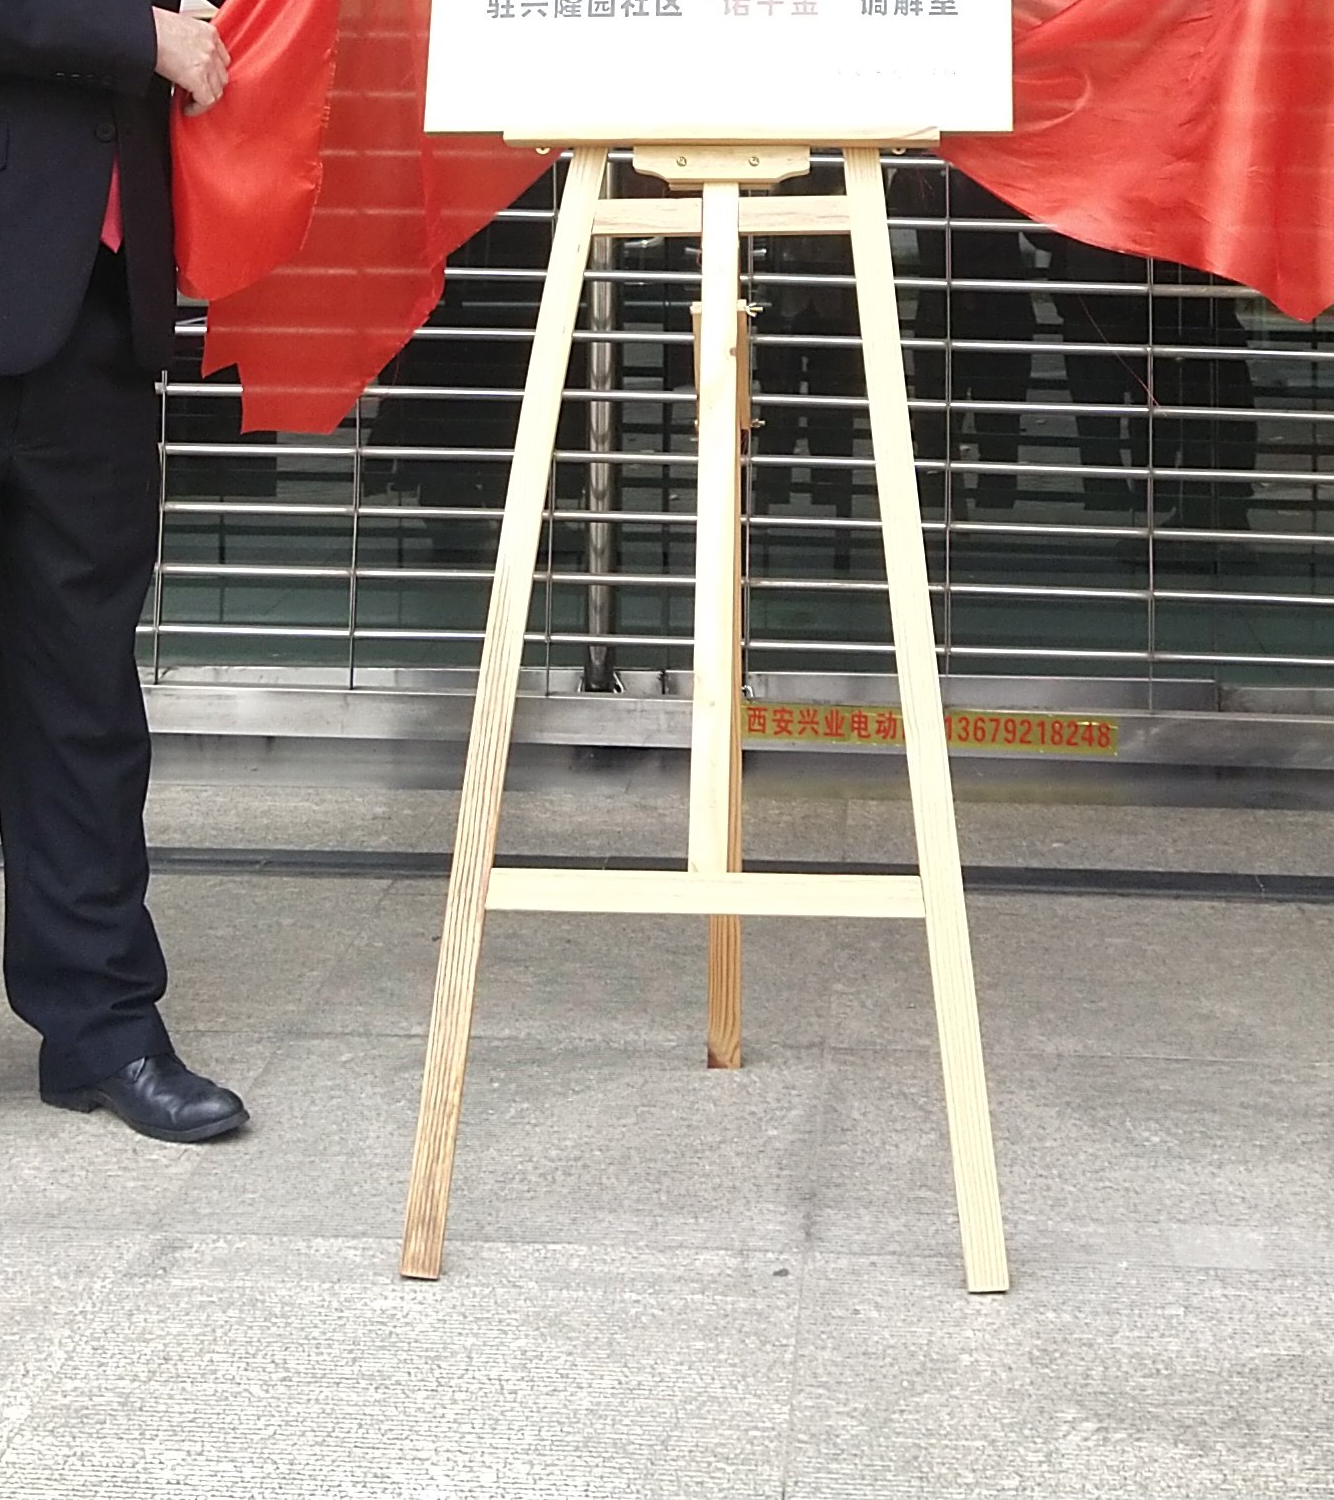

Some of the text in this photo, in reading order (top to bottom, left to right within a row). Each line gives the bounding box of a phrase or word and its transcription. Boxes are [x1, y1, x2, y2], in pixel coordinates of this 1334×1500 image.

[747, 706, 1111, 748] 西安兴业电动 13679218248
